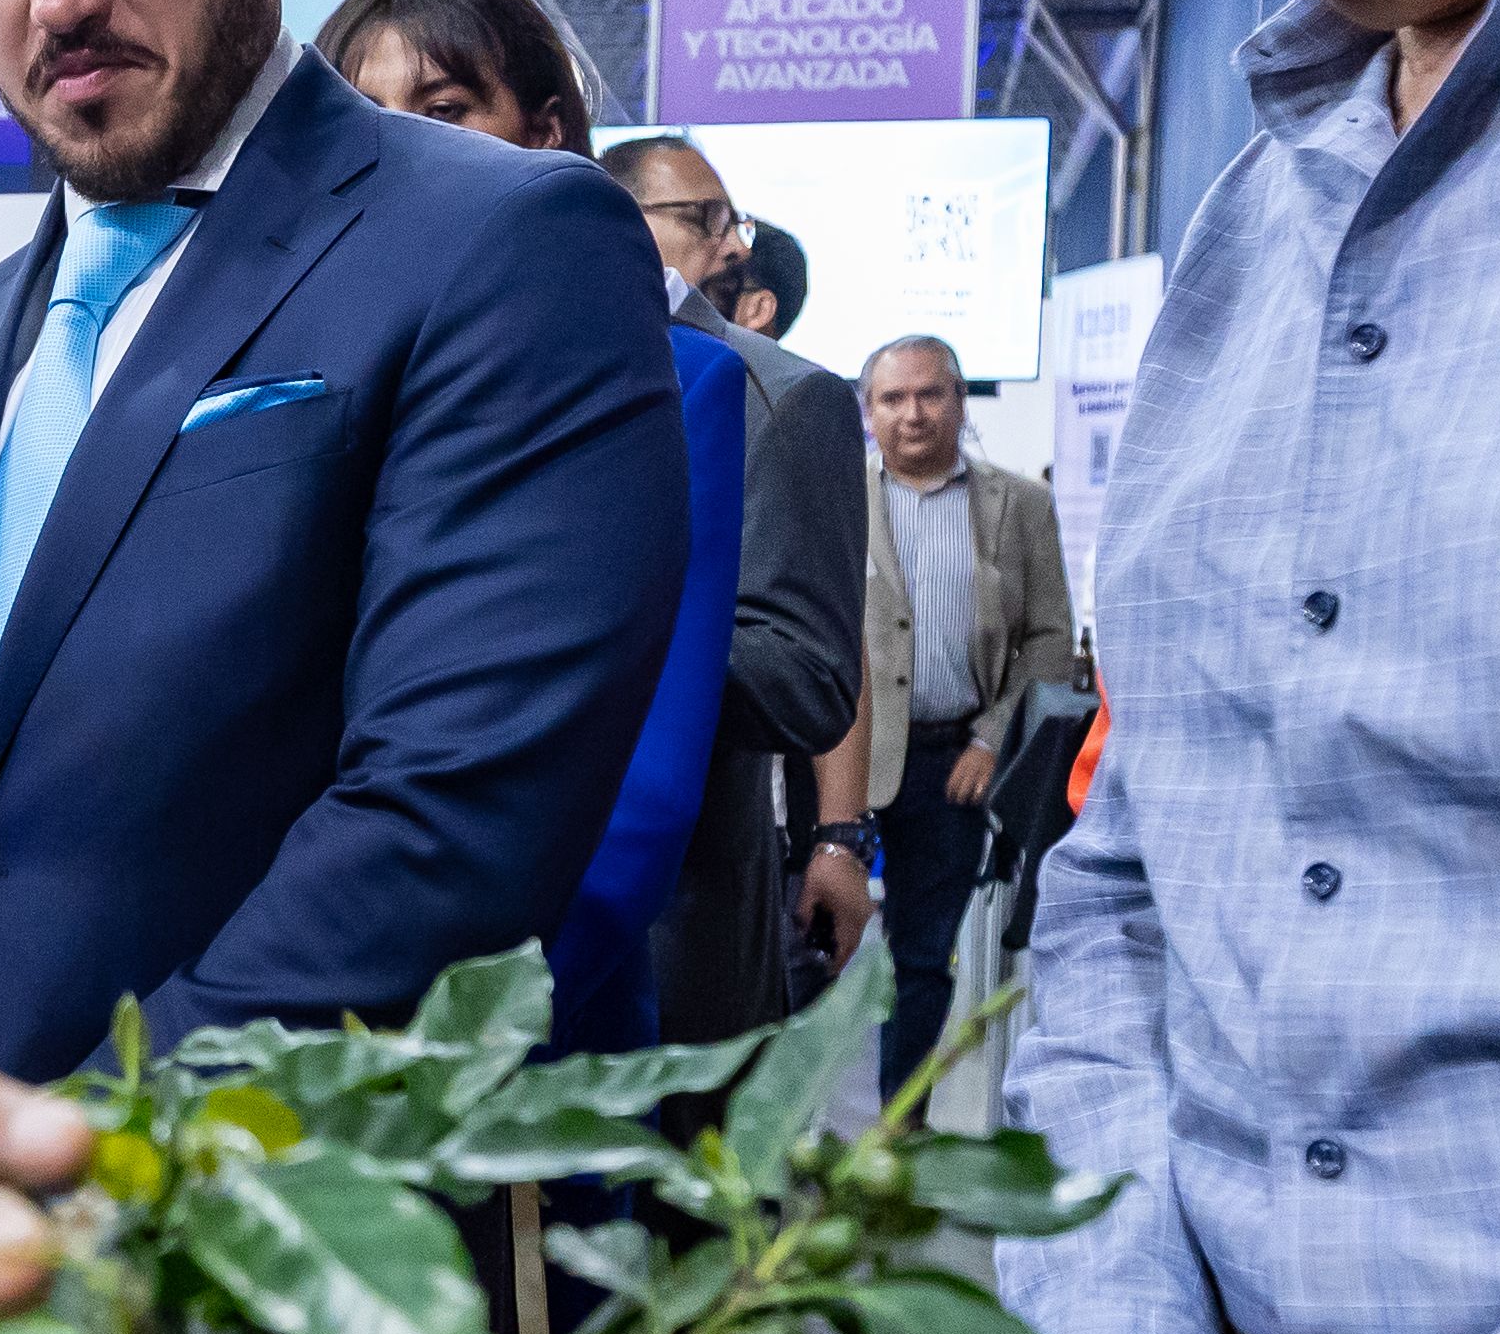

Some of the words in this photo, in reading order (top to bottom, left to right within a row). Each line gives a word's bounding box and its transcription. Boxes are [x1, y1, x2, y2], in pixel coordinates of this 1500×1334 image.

[682, 29, 707, 59] Y
[713, 21, 940, 58] TECNOLOGÍA
[714, 58, 910, 92] AVANZADA
